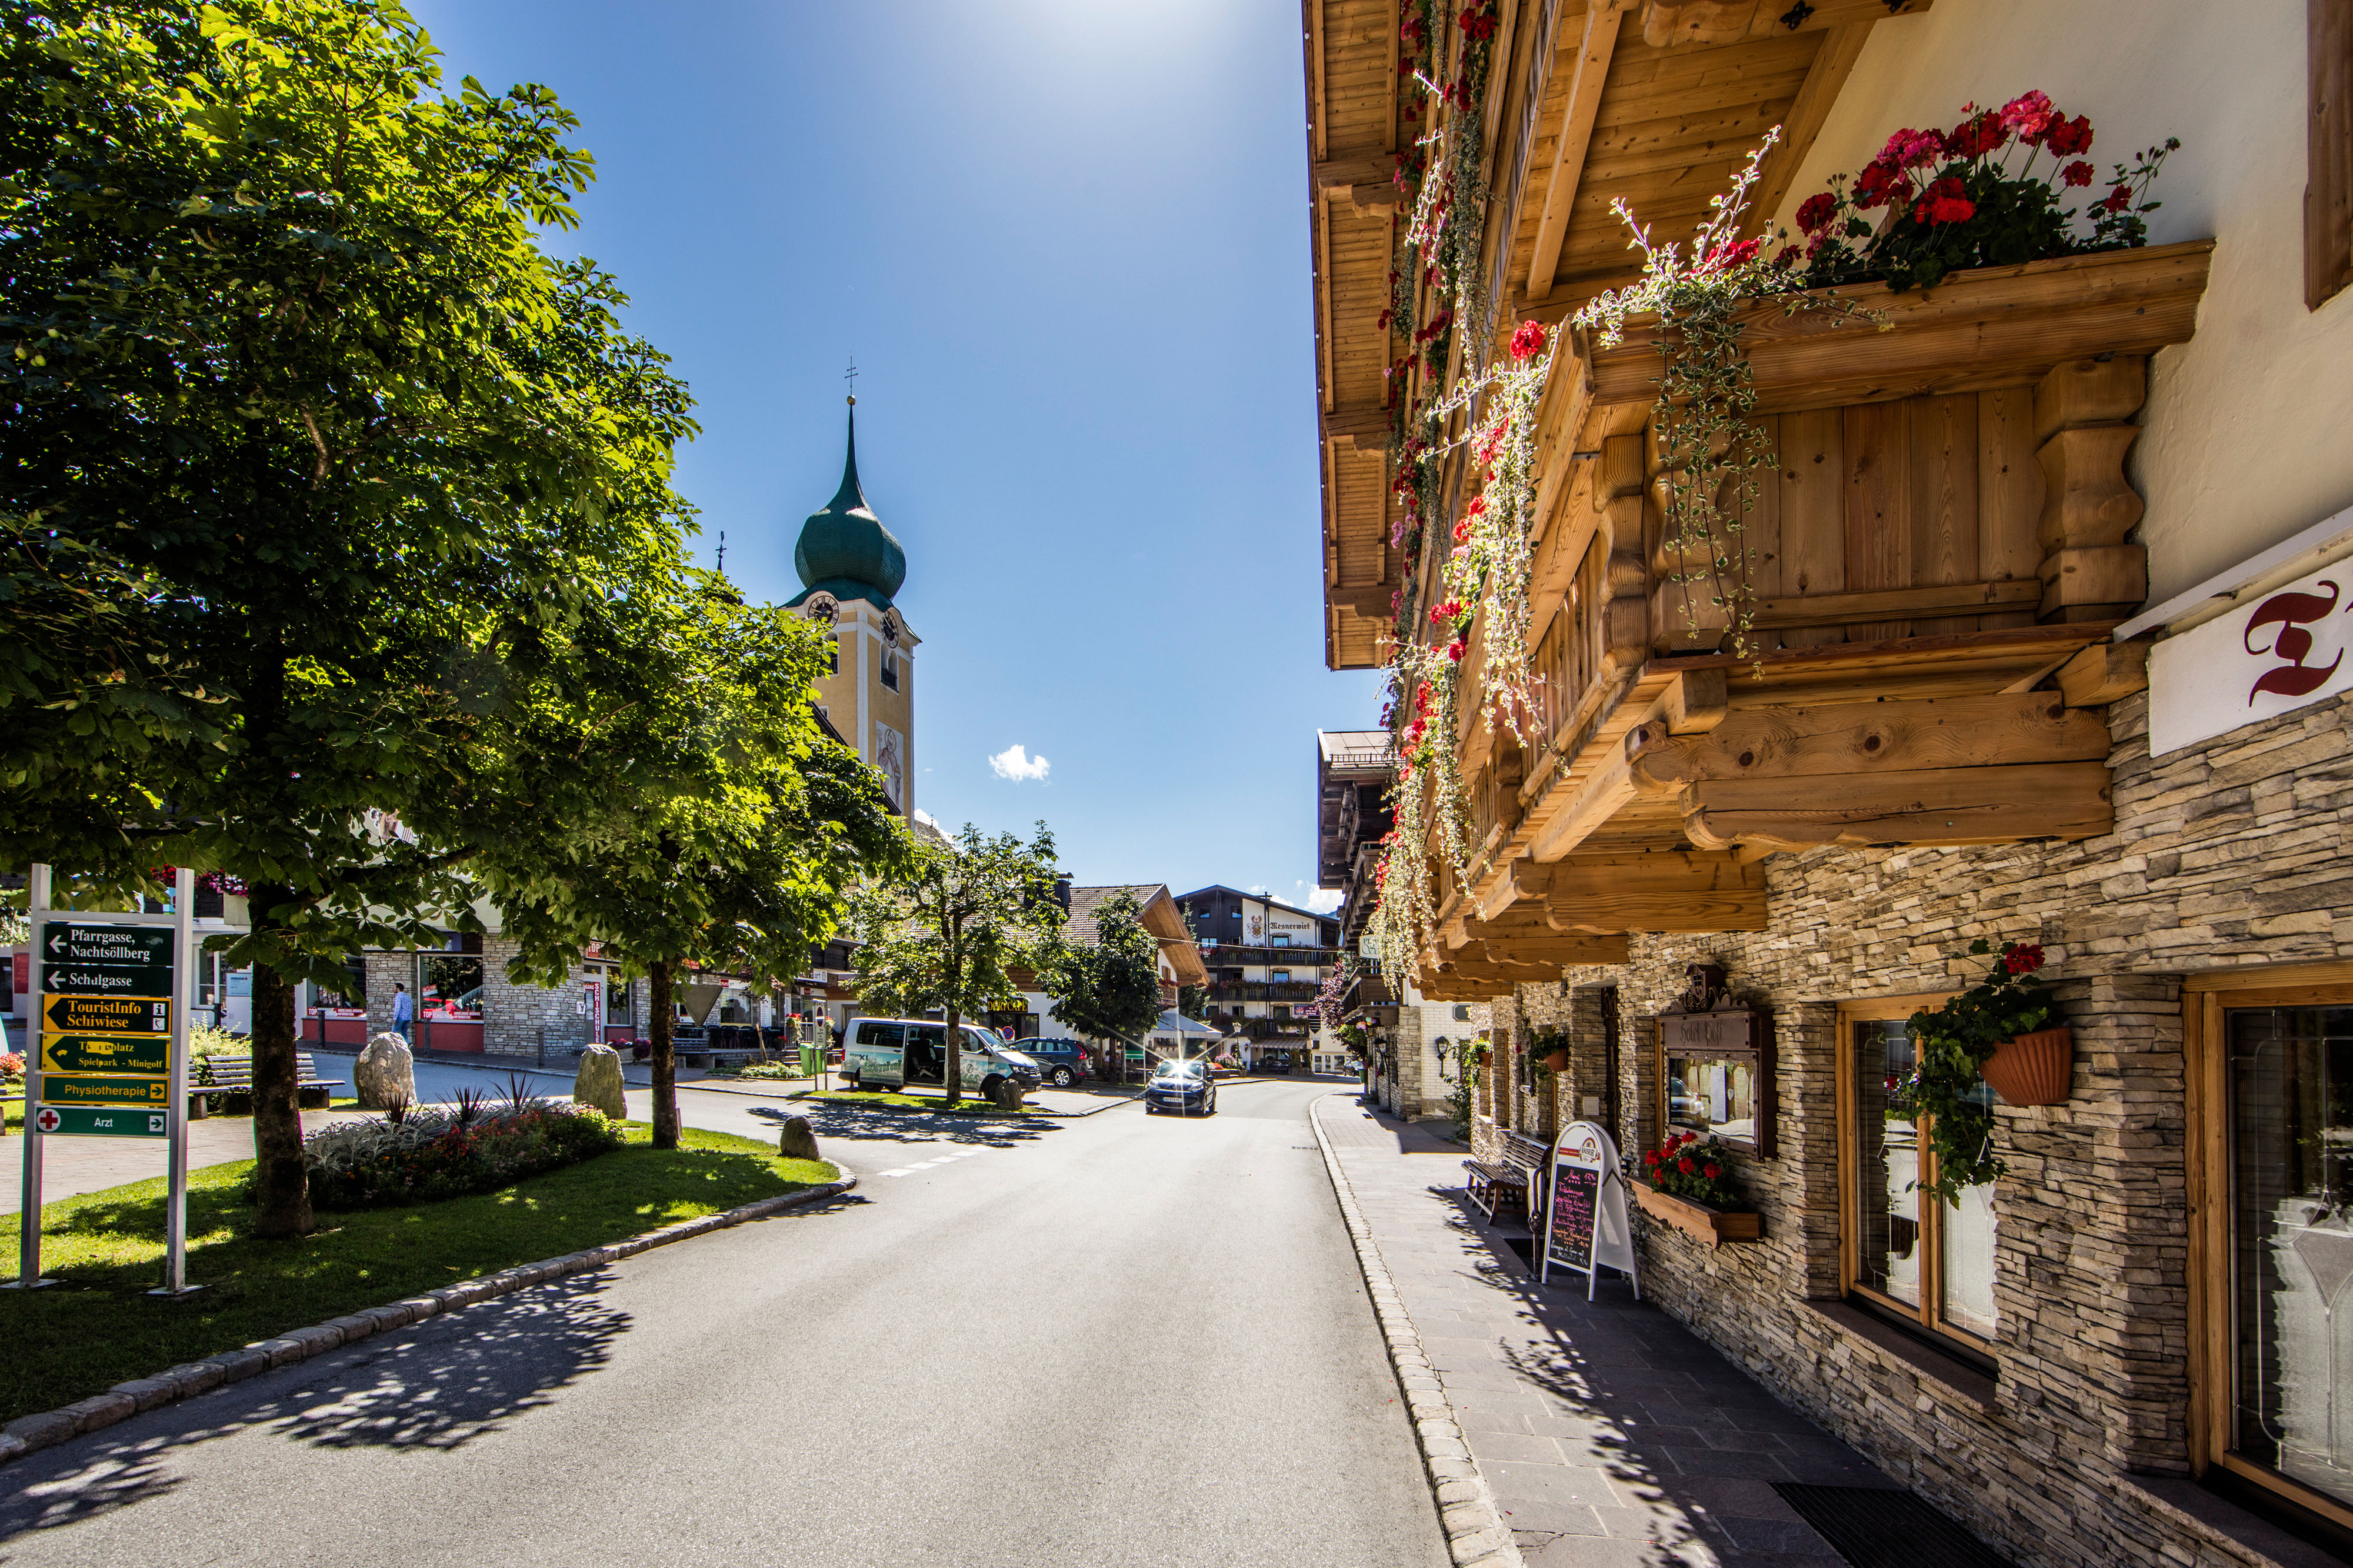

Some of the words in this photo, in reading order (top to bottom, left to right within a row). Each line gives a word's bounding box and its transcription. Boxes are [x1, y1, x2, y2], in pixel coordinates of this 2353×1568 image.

[1269, 922, 1310, 930] Mesnerwirt
[71, 929, 135, 945] Pfarrgasse,
[70, 945, 151, 962] Nachtsöllberg
[69, 972, 132, 989] Schulgasse
[68, 1000, 141, 1015] TouristInfo
[67, 1014, 129, 1028] Schiwiese
[79, 1057, 118, 1068] Spielpark
[128, 1059, 163, 1069] Minigolf
[65, 1085, 146, 1098] Physiotherapie
[94, 1117, 114, 1127] Arzt
[1581, 1147, 1595, 1157] KAISER
